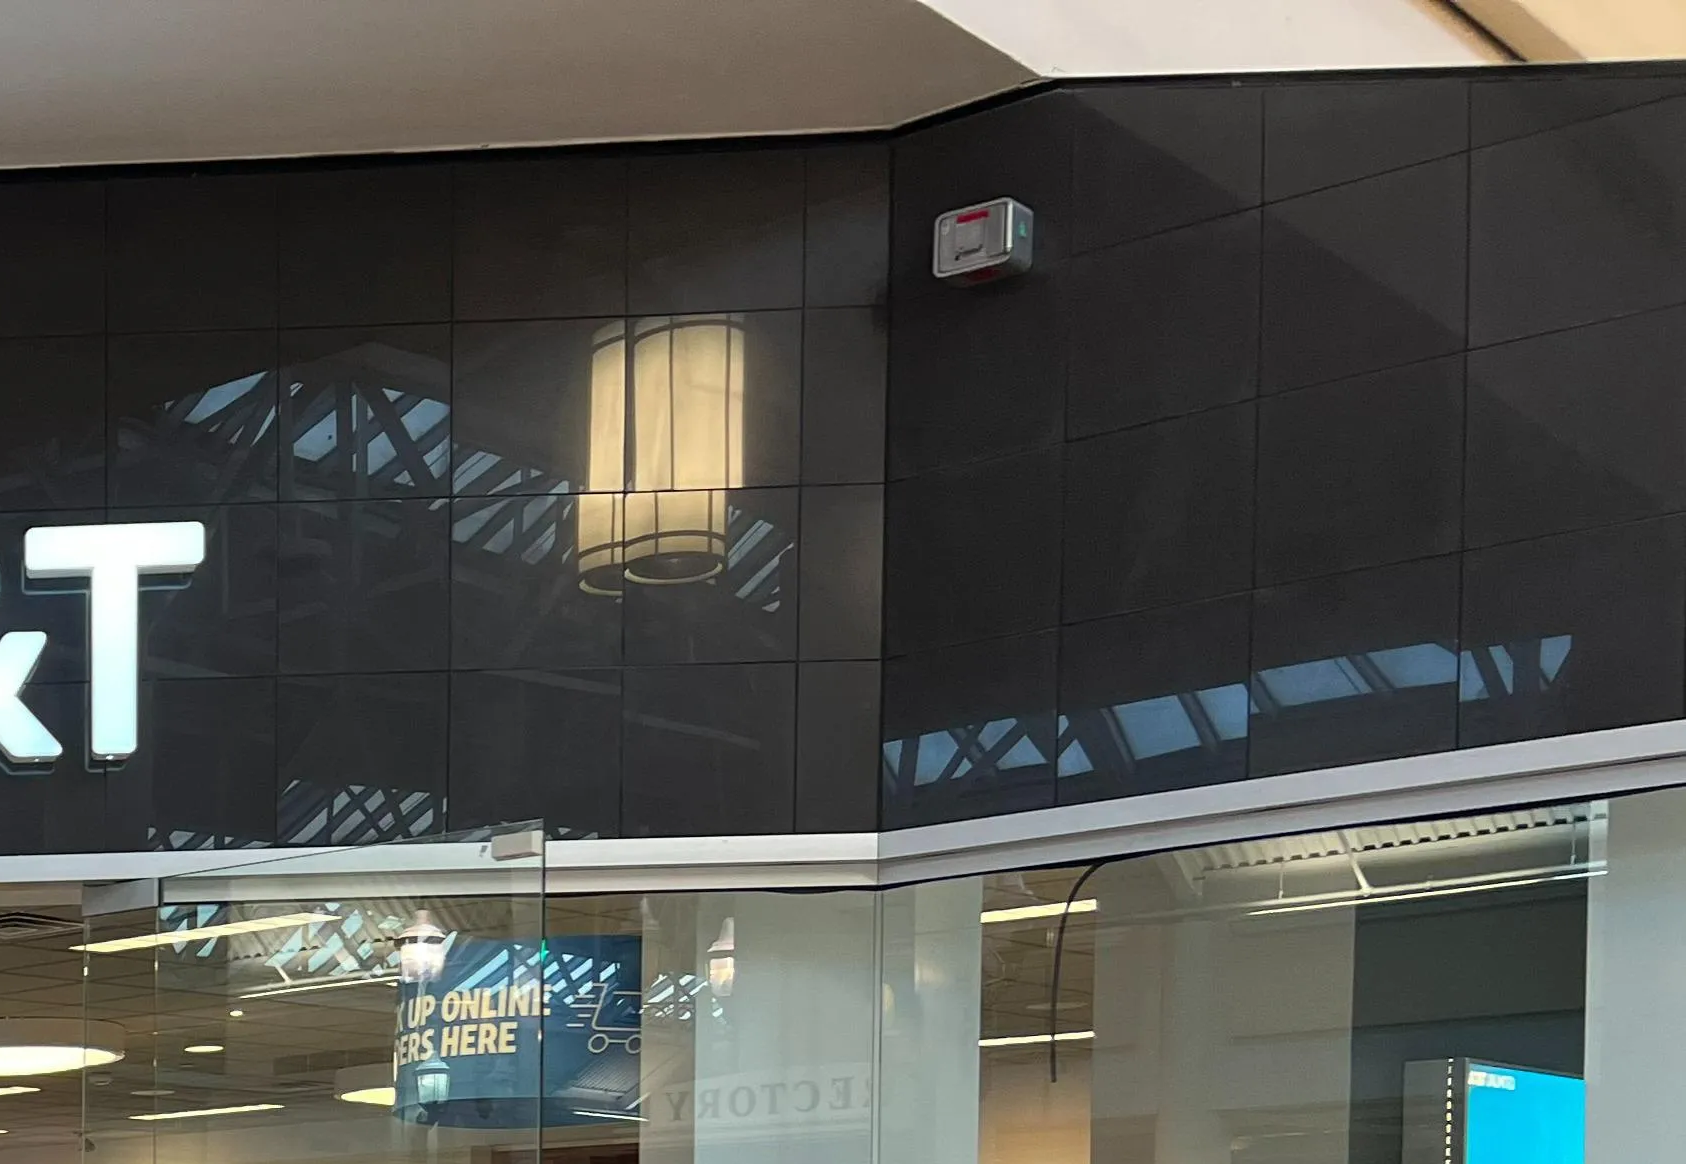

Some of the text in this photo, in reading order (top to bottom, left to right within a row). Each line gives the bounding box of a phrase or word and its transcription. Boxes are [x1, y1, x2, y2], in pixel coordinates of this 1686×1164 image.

[408, 994, 436, 1029] UP
[441, 984, 553, 1023] ONLINE
[395, 1021, 518, 1065] ERS HERE
